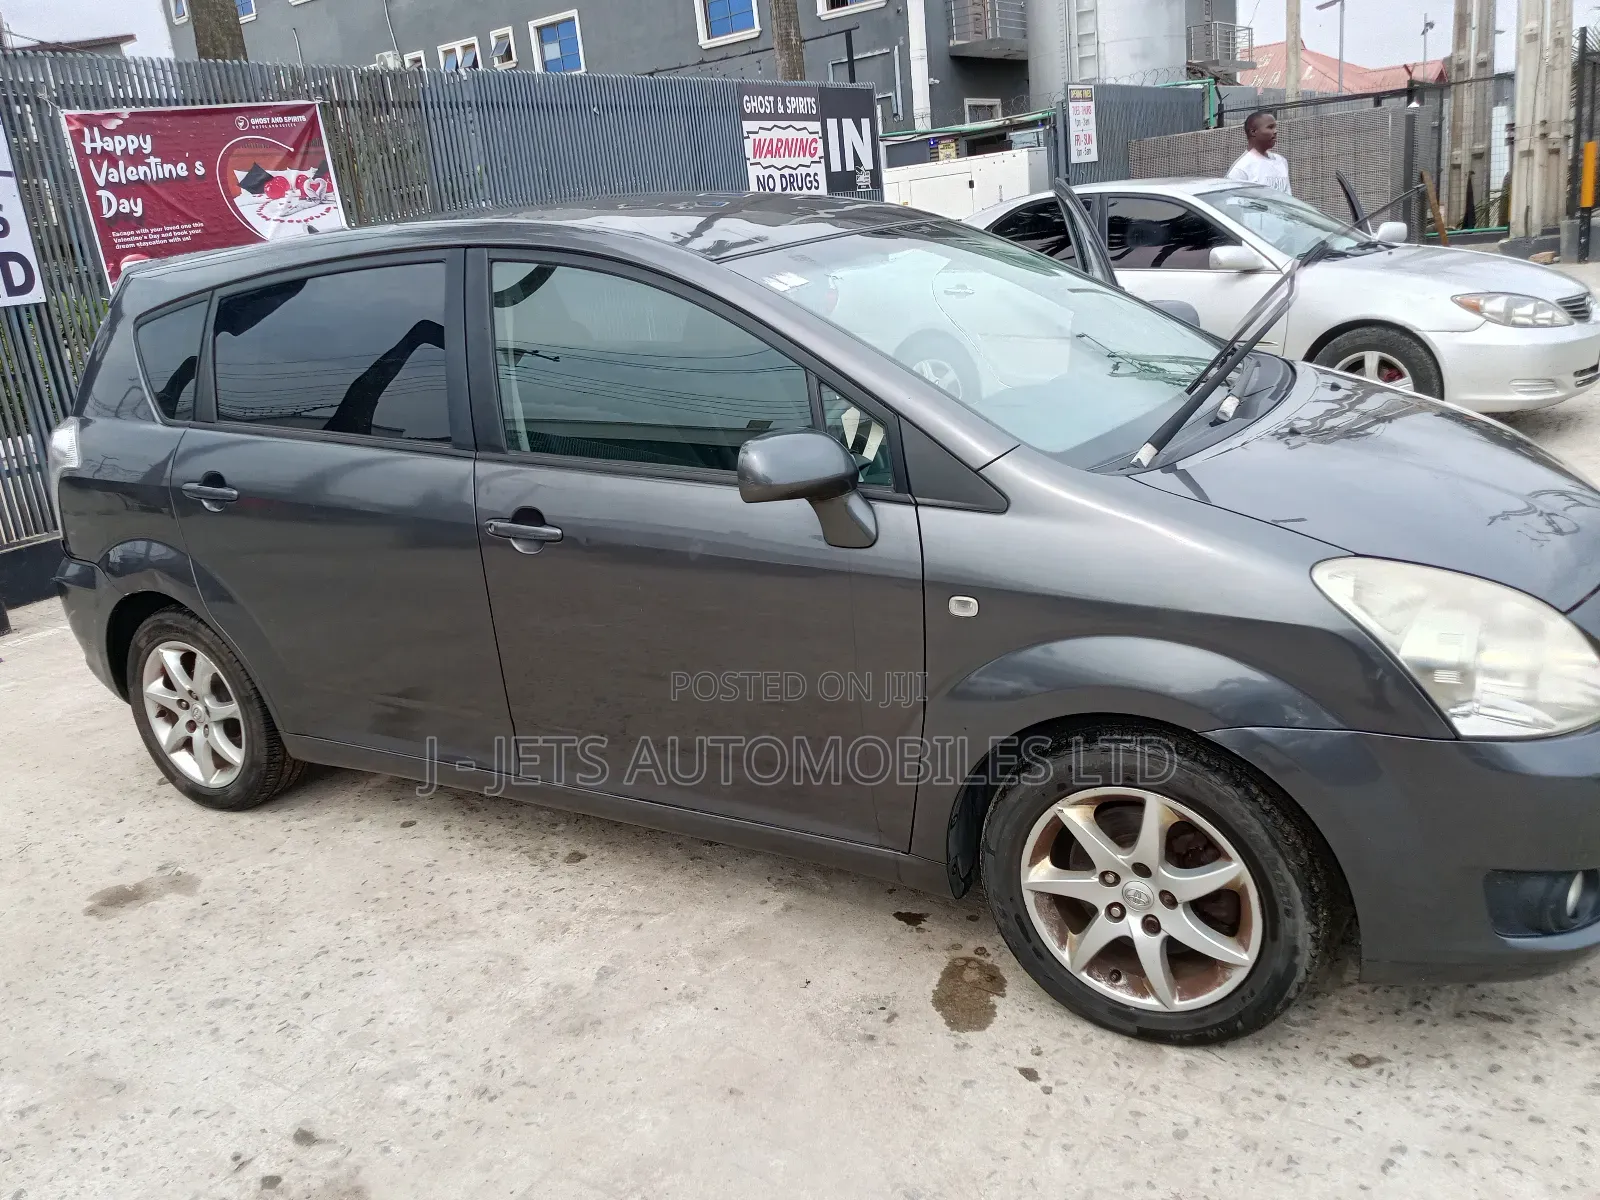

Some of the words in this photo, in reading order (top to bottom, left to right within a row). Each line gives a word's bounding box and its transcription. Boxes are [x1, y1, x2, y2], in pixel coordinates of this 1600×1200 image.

[743, 95, 775, 114] GHOST
[777, 96, 785, 114] &
[785, 96, 817, 115] SPIRITS
[250, 117, 270, 125] GHOST
[271, 116, 283, 124] AND
[284, 115, 307, 123] SPIRITS
[81, 126, 152, 156] Happy
[752, 137, 818, 159] WARNING
[826, 117, 873, 172] IN
[89, 152, 206, 187] Valentine's
[756, 174, 776, 192] NO
[779, 172, 820, 192] DRUGS
[96, 190, 144, 219] Day
[113, 234, 148, 243] Valentine's
[136, 239, 168, 248] staycation
[0, 251, 36, 298] D
